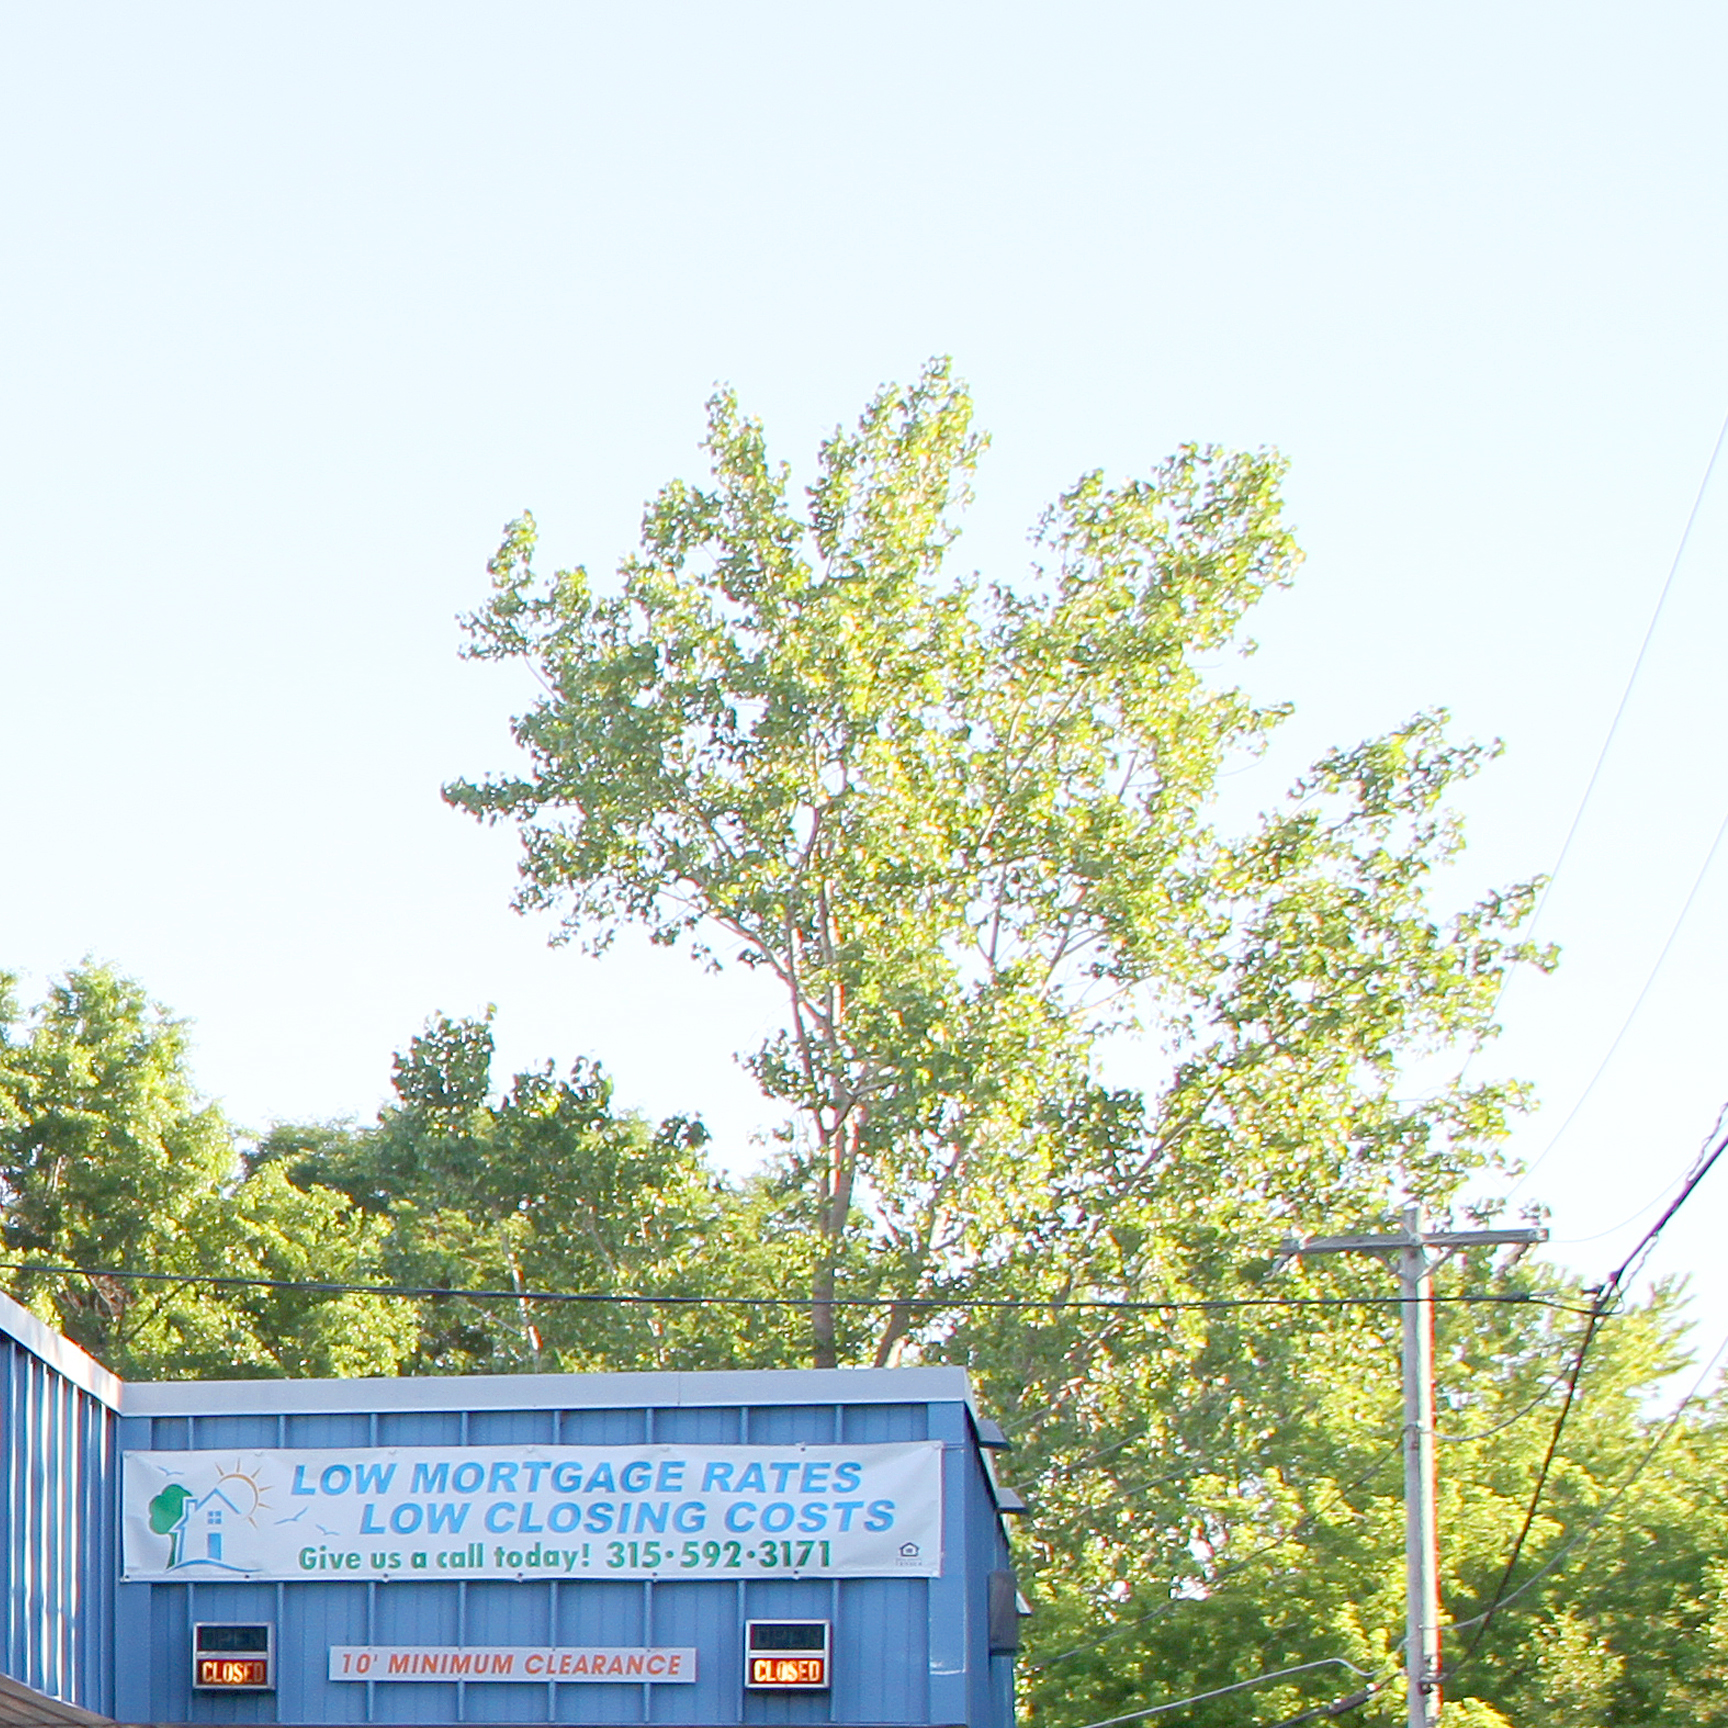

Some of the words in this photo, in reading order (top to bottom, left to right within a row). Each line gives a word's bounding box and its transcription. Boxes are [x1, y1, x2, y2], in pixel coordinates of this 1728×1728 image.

[291, 1464, 397, 1496] LOW
[411, 1461, 686, 1495] MORTGAGE
[701, 1461, 864, 1494] RATES
[359, 1502, 471, 1535] LOW
[484, 1501, 708, 1534] CLOSING
[723, 1500, 896, 1533] COSTS
[299, 1546, 361, 1570] Give
[370, 1551, 402, 1569] us
[411, 1550, 427, 1569] a
[437, 1543, 484, 1568] call
[494, 1542, 591, 1573] today!
[201, 1660, 264, 1684] CLOSED
[343, 1654, 379, 1675] 10'
[387, 1654, 514, 1675] MINIMUM
[524, 1654, 682, 1676] CLEARANCE
[753, 1658, 821, 1683] CLOSED
